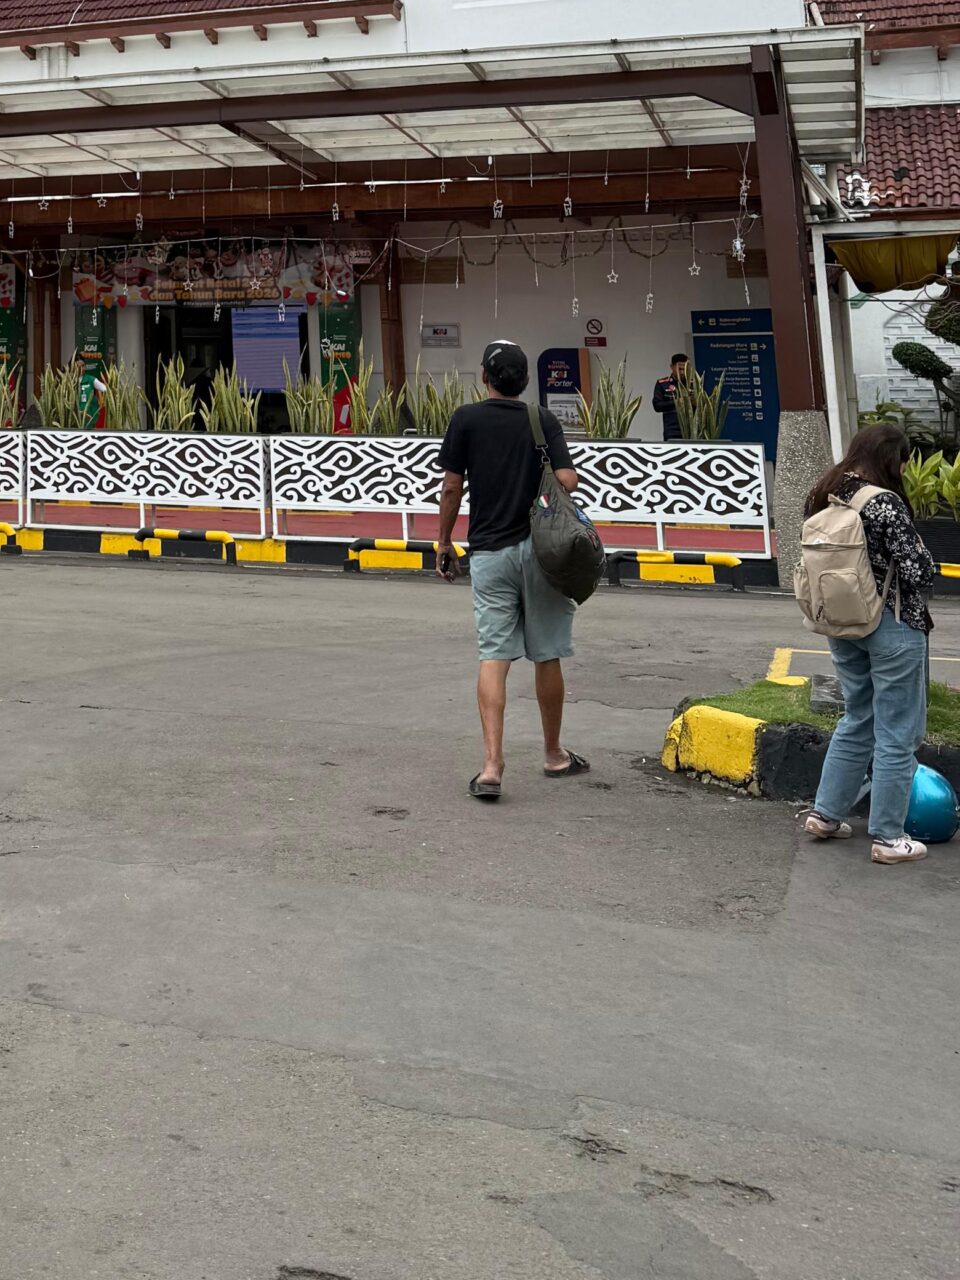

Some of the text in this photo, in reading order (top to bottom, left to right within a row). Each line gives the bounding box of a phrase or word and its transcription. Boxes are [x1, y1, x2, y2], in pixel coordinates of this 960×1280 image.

[206, 277, 241, 288] Natal
[149, 287, 279, 301] dan Tahun Baru 2026
[83, 344, 98, 352] KAI
[330, 343, 346, 351] KAI
[546, 377, 574, 388] Porter
